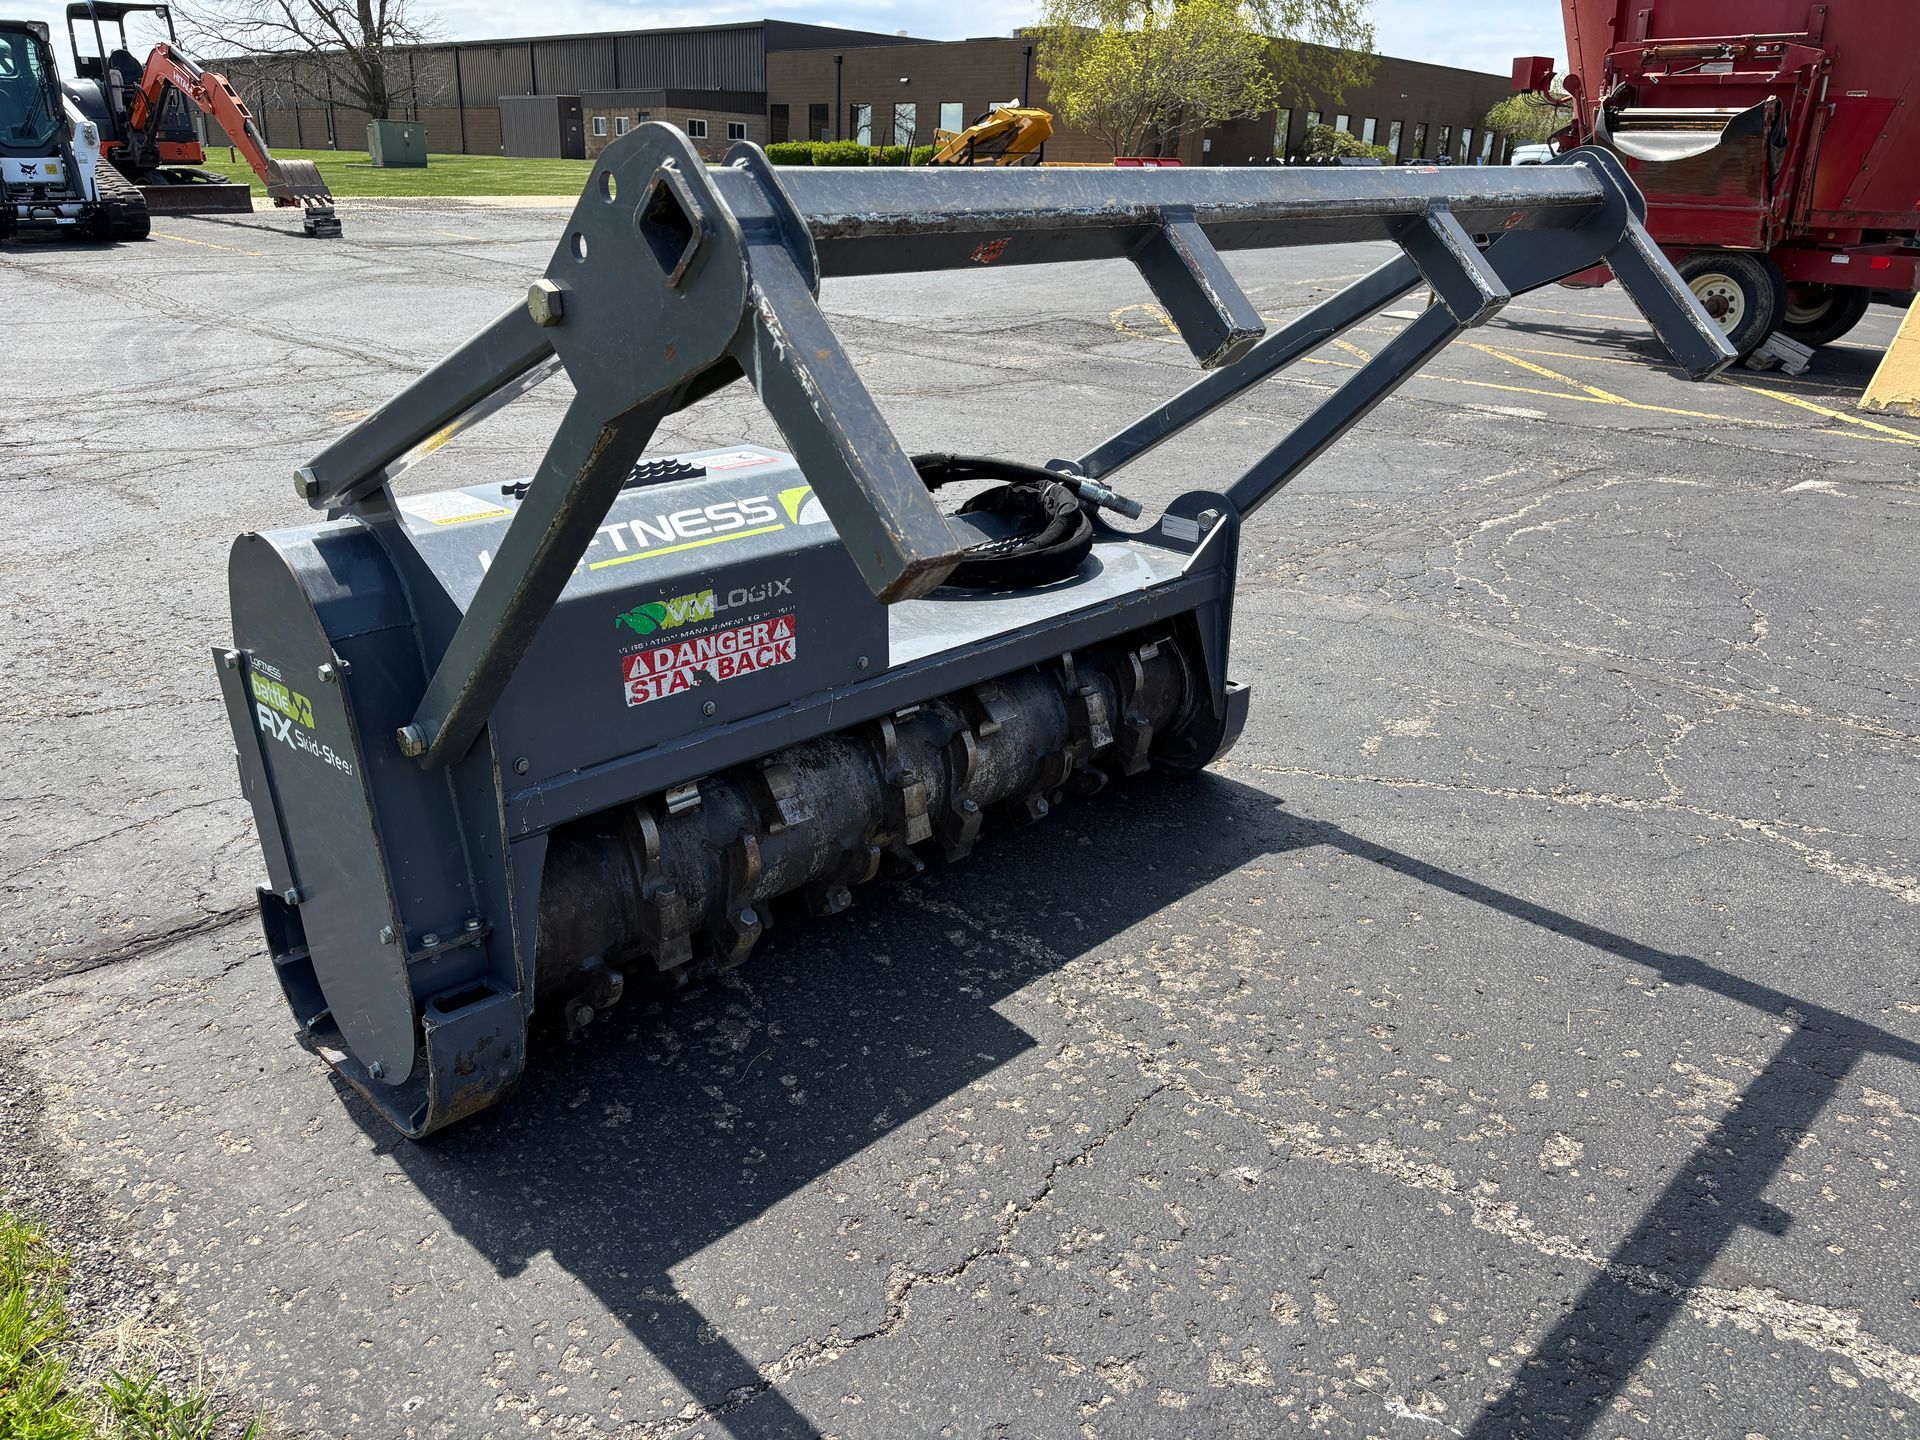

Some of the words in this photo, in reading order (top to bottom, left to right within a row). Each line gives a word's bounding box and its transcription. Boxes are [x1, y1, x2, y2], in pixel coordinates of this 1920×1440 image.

[654, 623, 769, 672] DANGER
[717, 640, 793, 680] BACK
[256, 702, 297, 750] AX
